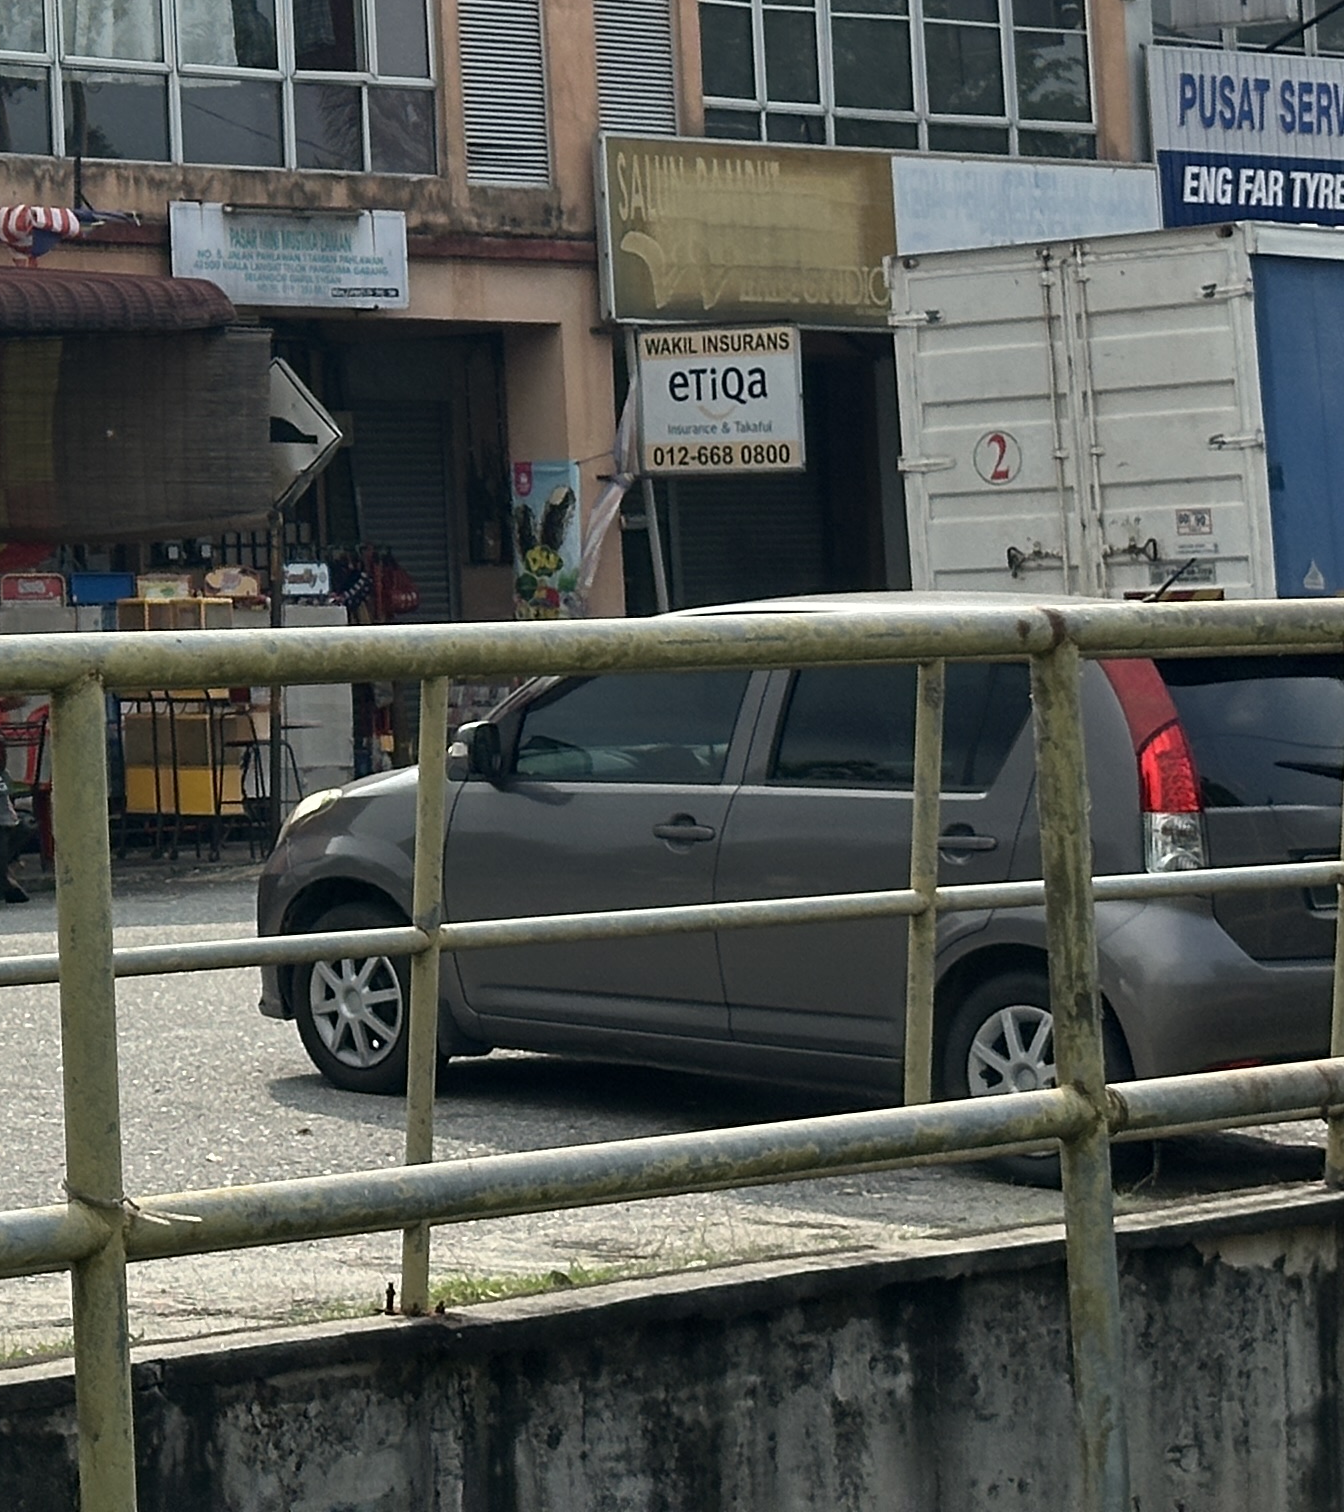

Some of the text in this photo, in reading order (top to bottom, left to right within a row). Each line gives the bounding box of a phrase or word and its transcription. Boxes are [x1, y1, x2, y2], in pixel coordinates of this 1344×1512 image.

[1179, 72, 1270, 131] PUSAT
[1183, 165, 1232, 205] ENG
[1238, 168, 1284, 207] FAR
[644, 332, 790, 356] WAKIL INSURANS
[667, 420, 773, 436] Insurance & Takaful
[653, 444, 790, 466] 012-668 0800
[987, 433, 1010, 481] 2
